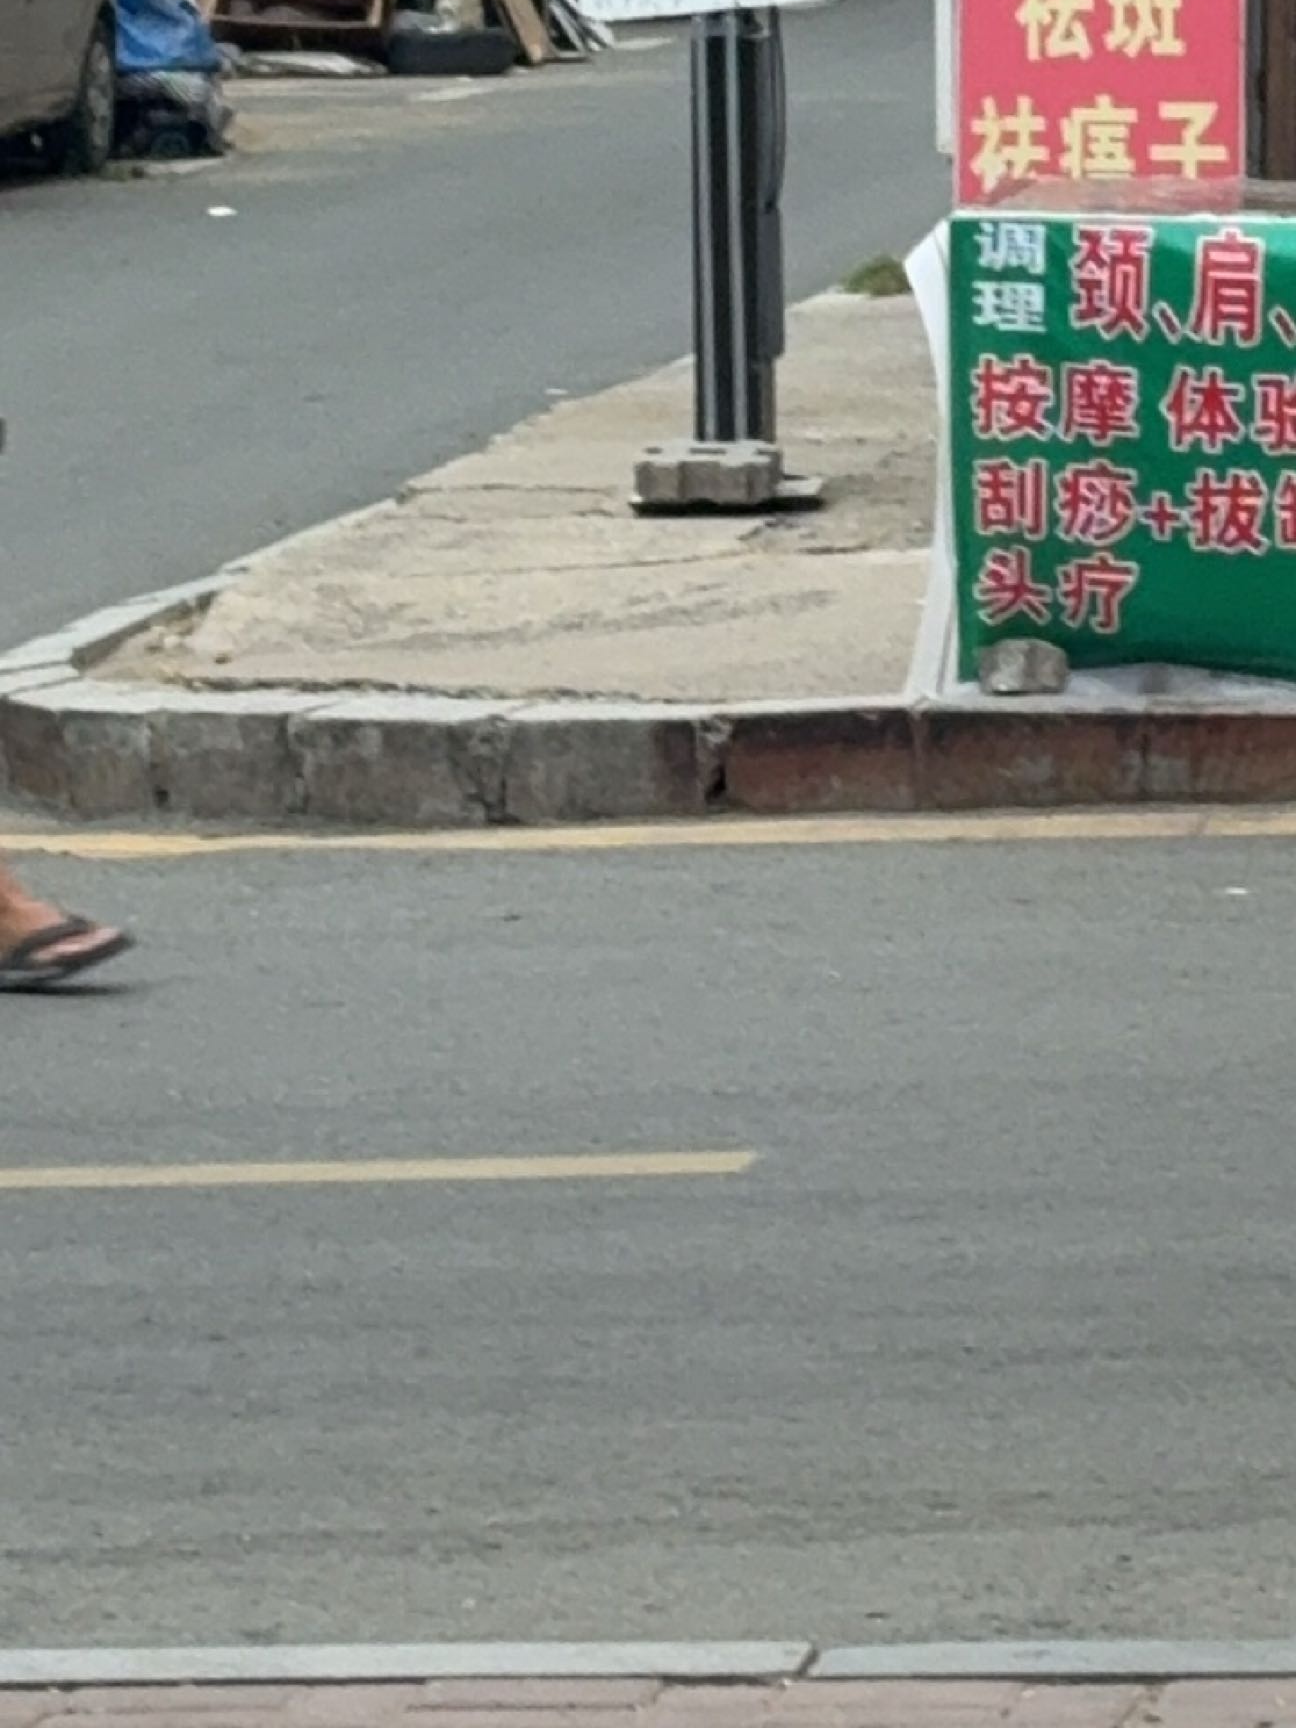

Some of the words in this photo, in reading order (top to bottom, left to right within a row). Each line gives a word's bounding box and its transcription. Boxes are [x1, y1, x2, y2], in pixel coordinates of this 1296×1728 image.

[971, 221, 1047, 332] 调理
[971, 354, 1140, 446] 按摩
[972, 545, 1139, 634] 头疗
